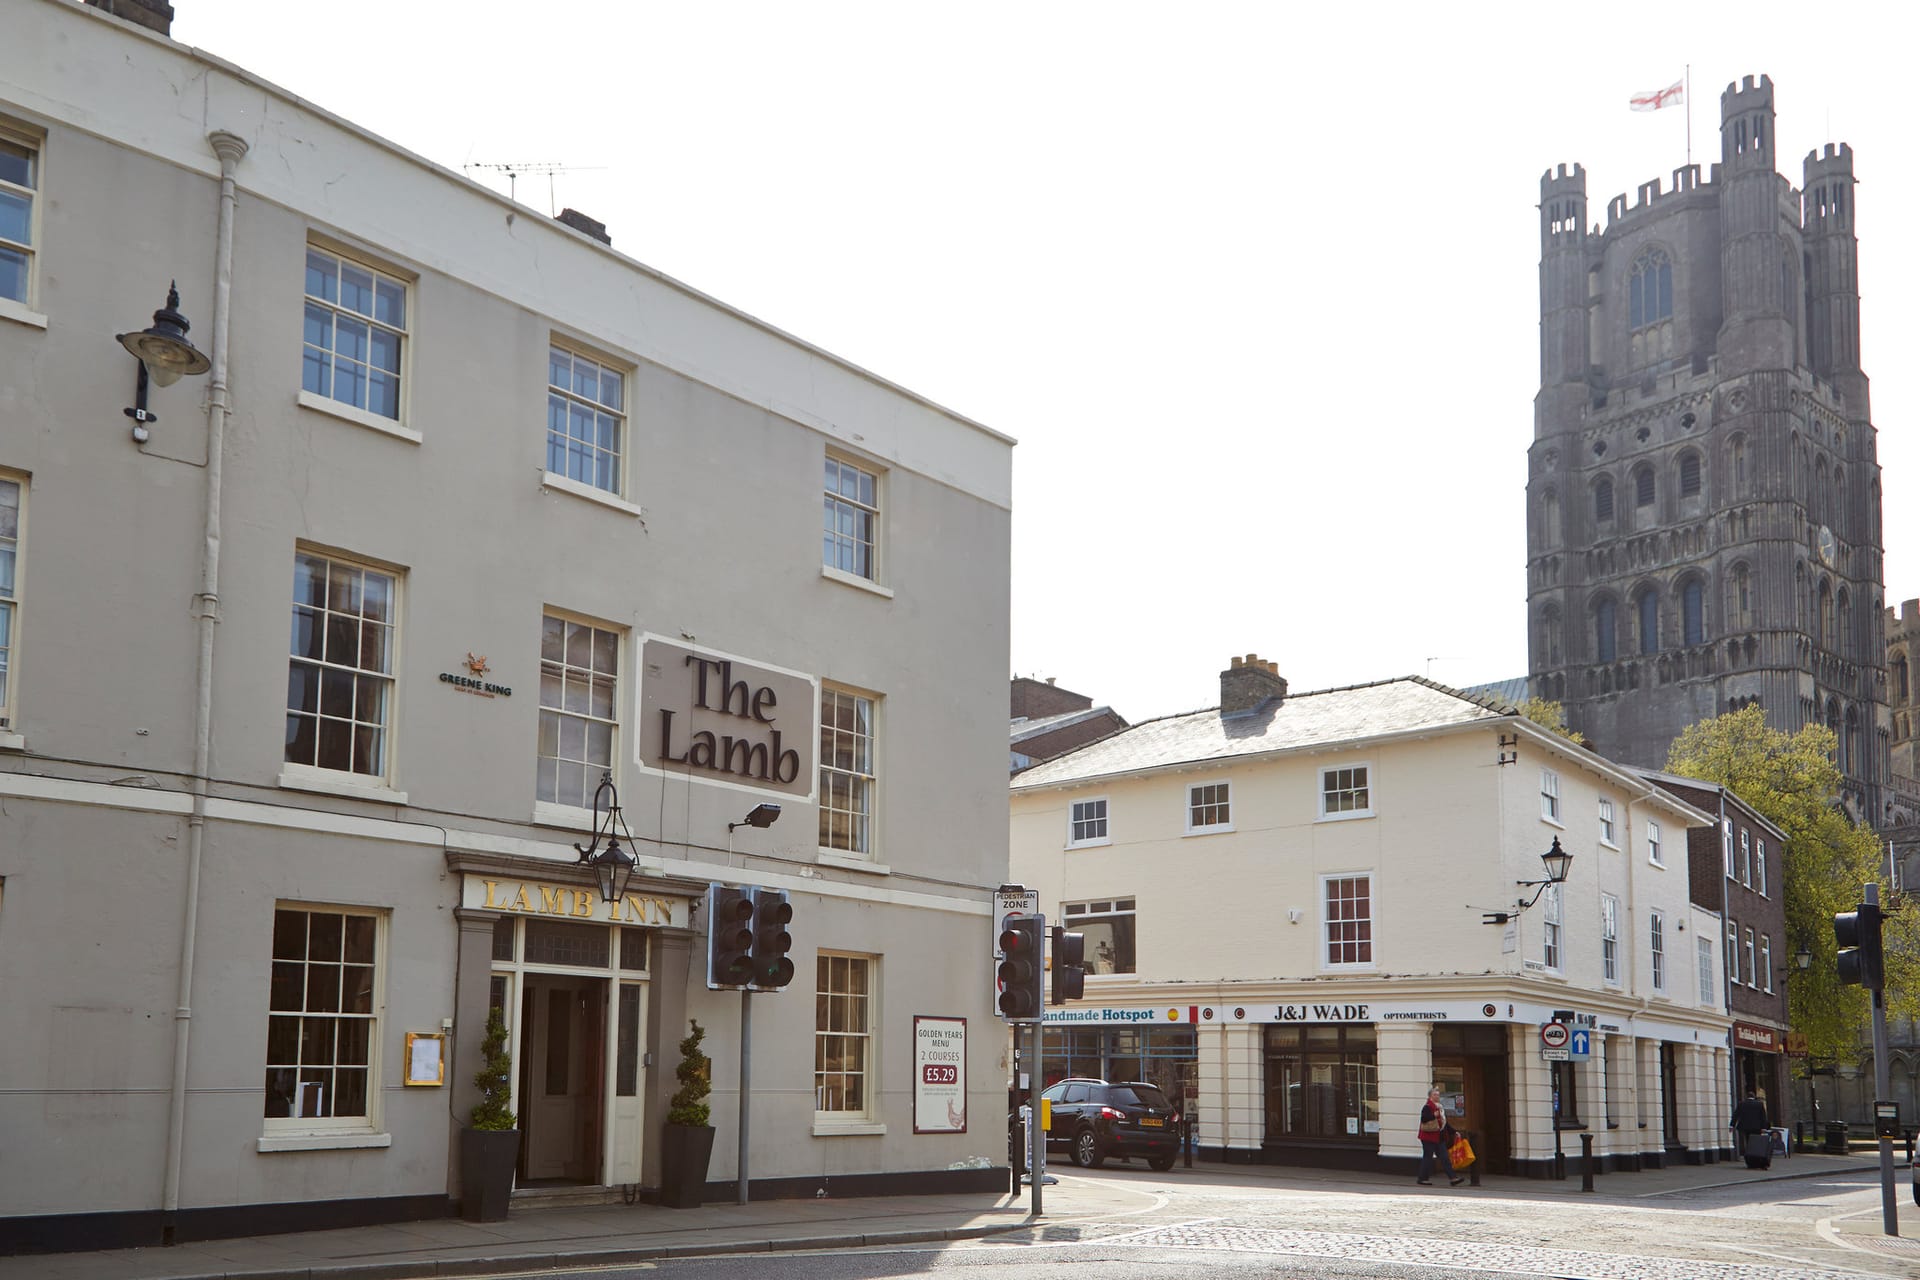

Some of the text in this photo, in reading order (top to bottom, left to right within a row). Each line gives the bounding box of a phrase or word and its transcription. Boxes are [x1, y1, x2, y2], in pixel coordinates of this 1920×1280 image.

[439, 673, 482, 690] GREENE
[485, 682, 512, 697] KING
[686, 655, 776, 722] The
[658, 708, 800, 784] Lamb
[482, 880, 674, 925] LAMB INN
[1003, 900, 1029, 909] ZONE
[1043, 1009, 1155, 1022] andmade Hotspot
[1274, 1004, 1448, 1021] J&J WADE OPTOMETRISTS
[919, 1029, 963, 1039] GOLDEN YEARS
[932, 1039, 950, 1048] MENU
[921, 1051, 960, 1062] 2 COURSES
[926, 1068, 955, 1082] £5.29
